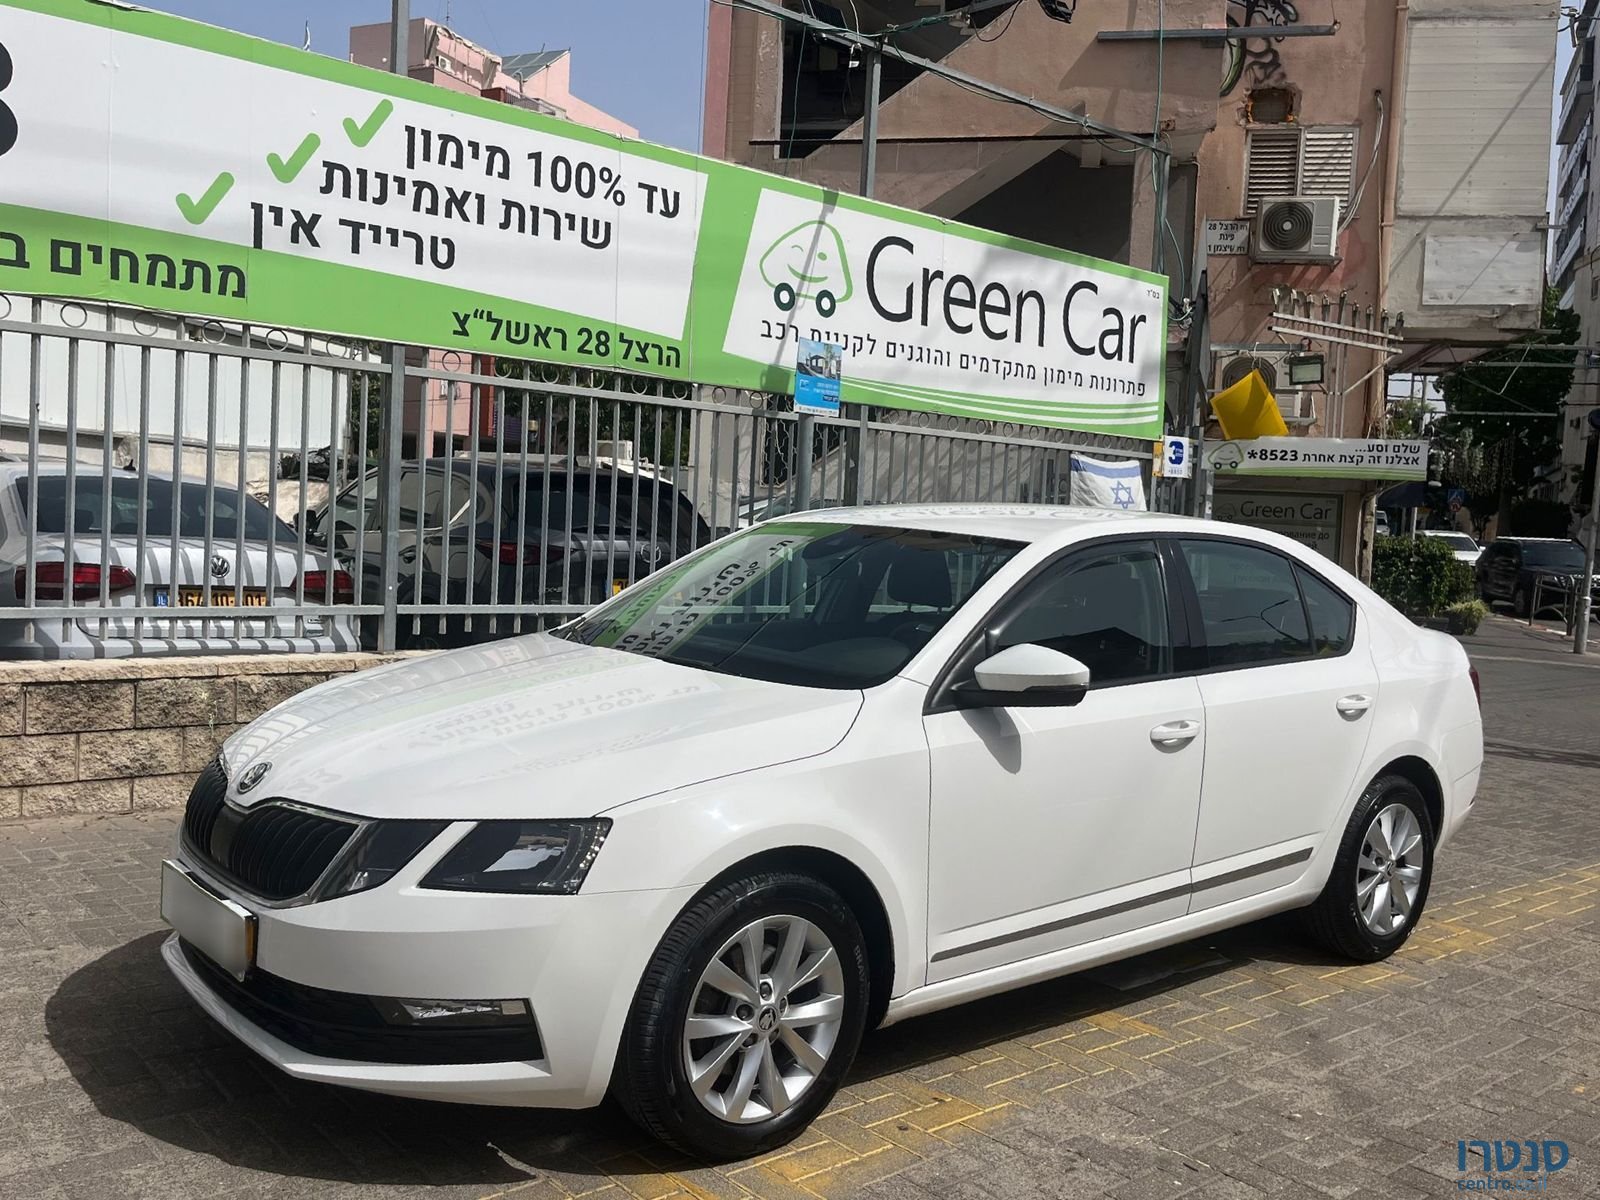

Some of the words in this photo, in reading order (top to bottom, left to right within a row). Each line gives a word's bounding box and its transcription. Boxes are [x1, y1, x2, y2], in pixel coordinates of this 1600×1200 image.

[404, 124, 510, 181] מימון
[319, 160, 486, 225] ואמינות
[528, 151, 626, 207] 100%
[638, 182, 680, 219] עד
[249, 201, 322, 248] אין
[499, 199, 612, 250] שירות
[338, 218, 457, 270] טרייד
[50, 239, 247, 299] מתמחים
[866, 236, 1047, 349] Green
[1062, 280, 1147, 365] Car
[577, 326, 611, 358] 28
[760, 319, 800, 344] רכב
[810, 328, 877, 358] לקניית
[618, 332, 681, 369] הרצל
[886, 341, 951, 368] והוגנים
[959, 353, 1036, 381] מתקדמים
[1043, 366, 1083, 387] מימון
[1089, 373, 1147, 398] פתרונות
[1302, 452, 1335, 464] אחרת
[1339, 454, 1364, 467] קצת
[1368, 454, 1382, 465] זה
[1385, 454, 1420, 466] אצלנו
[1393, 443, 1421, 454] שלם
[1240, 500, 1296, 518] Green
[1299, 502, 1333, 520] Car
